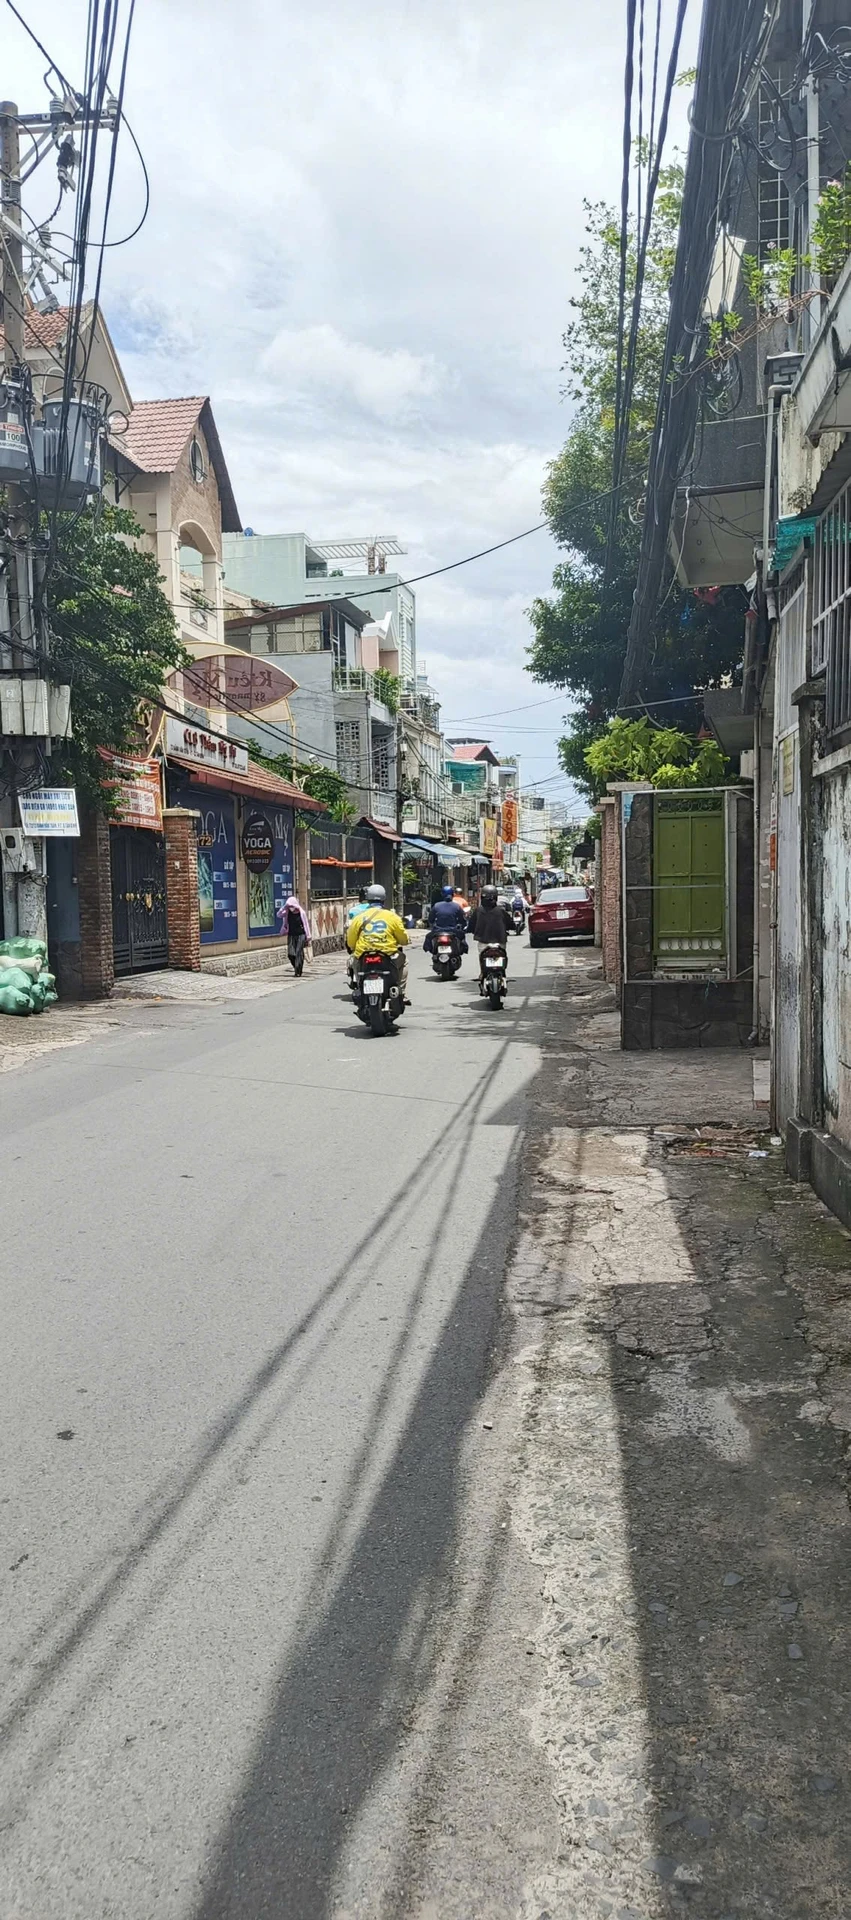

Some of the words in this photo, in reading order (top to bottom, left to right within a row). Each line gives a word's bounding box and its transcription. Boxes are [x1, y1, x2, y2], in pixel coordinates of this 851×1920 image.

[7, 433, 20, 442] 100
[200, 836, 212, 846] 72
[243, 837, 272, 848] YOGA
